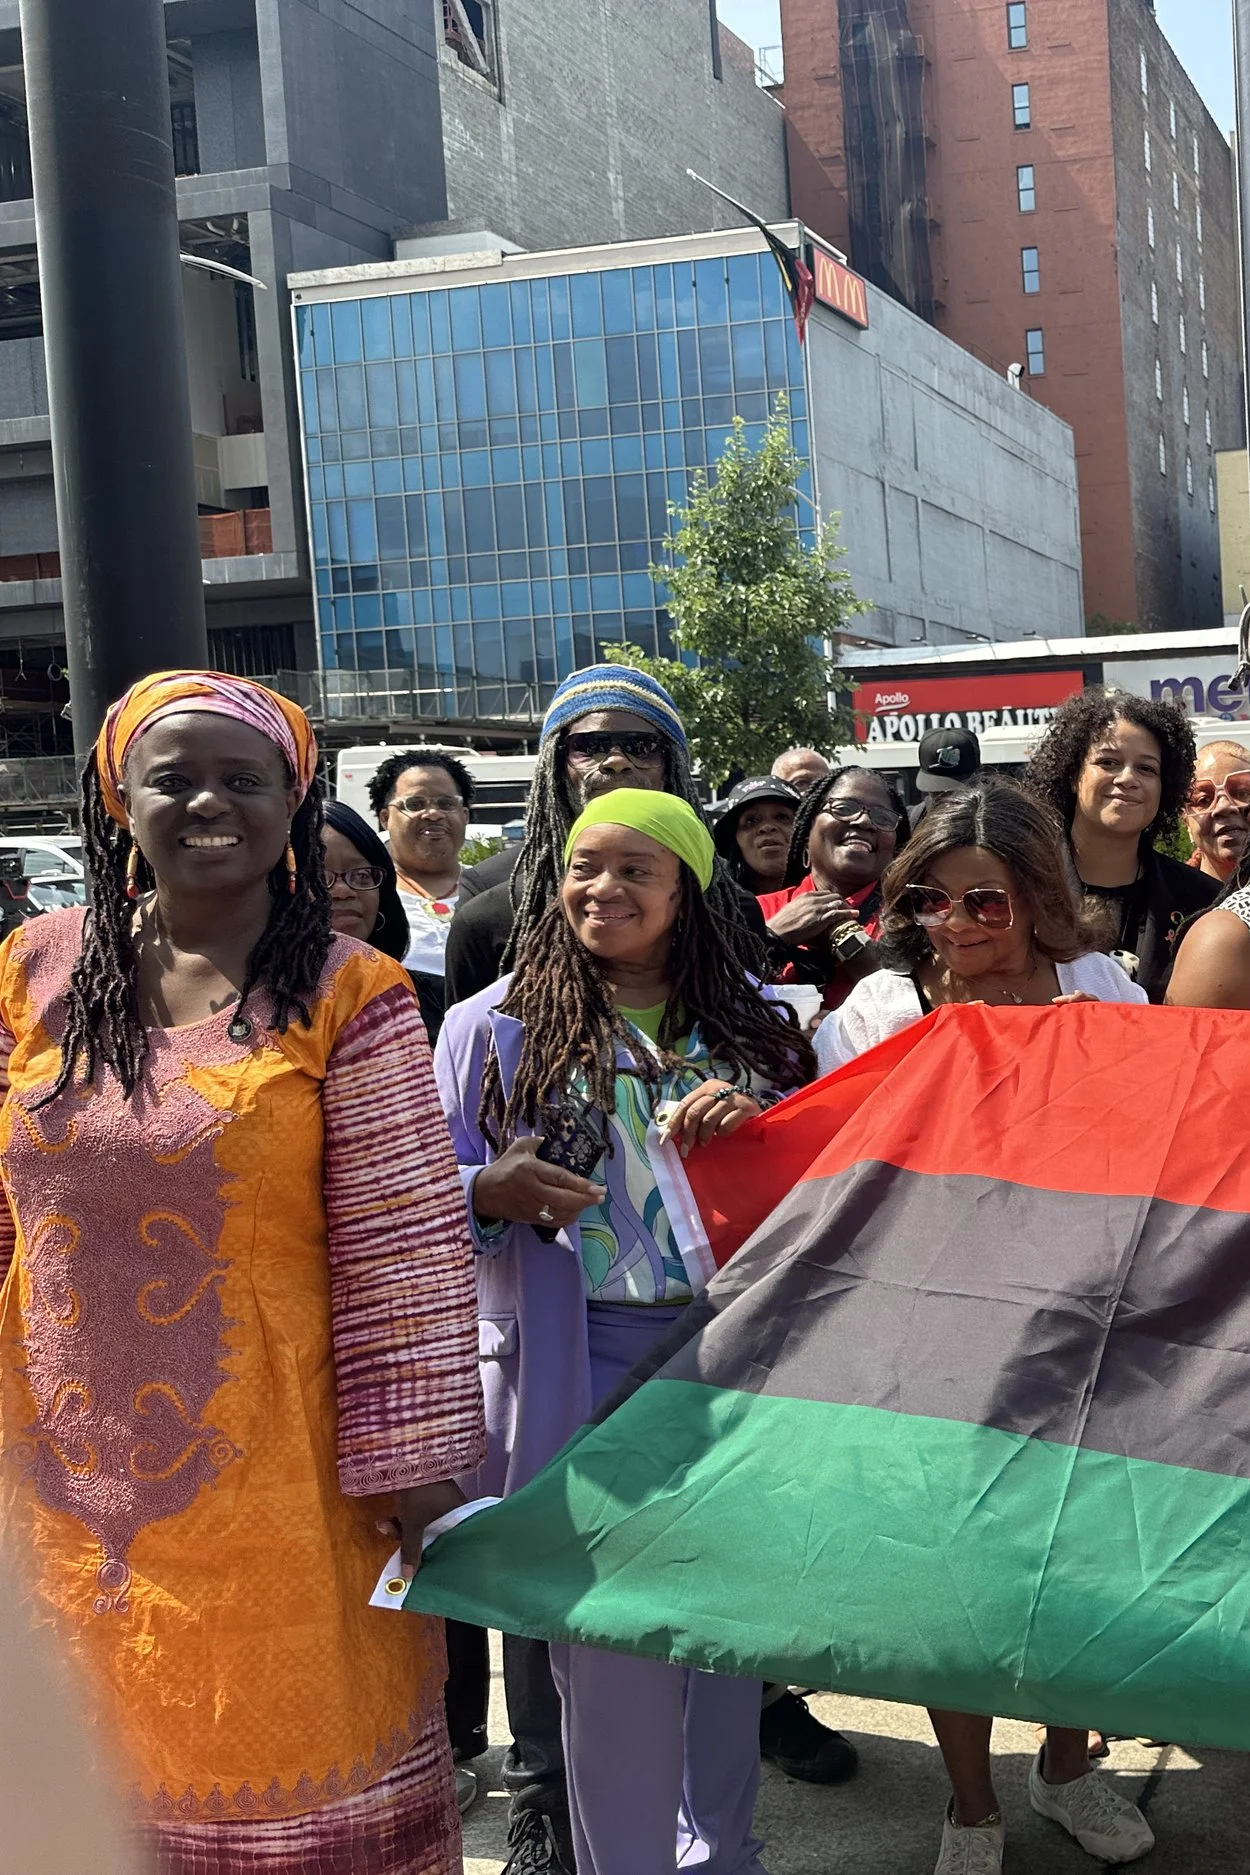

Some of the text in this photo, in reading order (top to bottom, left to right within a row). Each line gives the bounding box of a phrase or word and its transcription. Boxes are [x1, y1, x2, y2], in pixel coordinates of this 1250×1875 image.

[875, 692, 909, 705] Apollo
[867, 707, 1059, 743] APOLLO BEAUT
